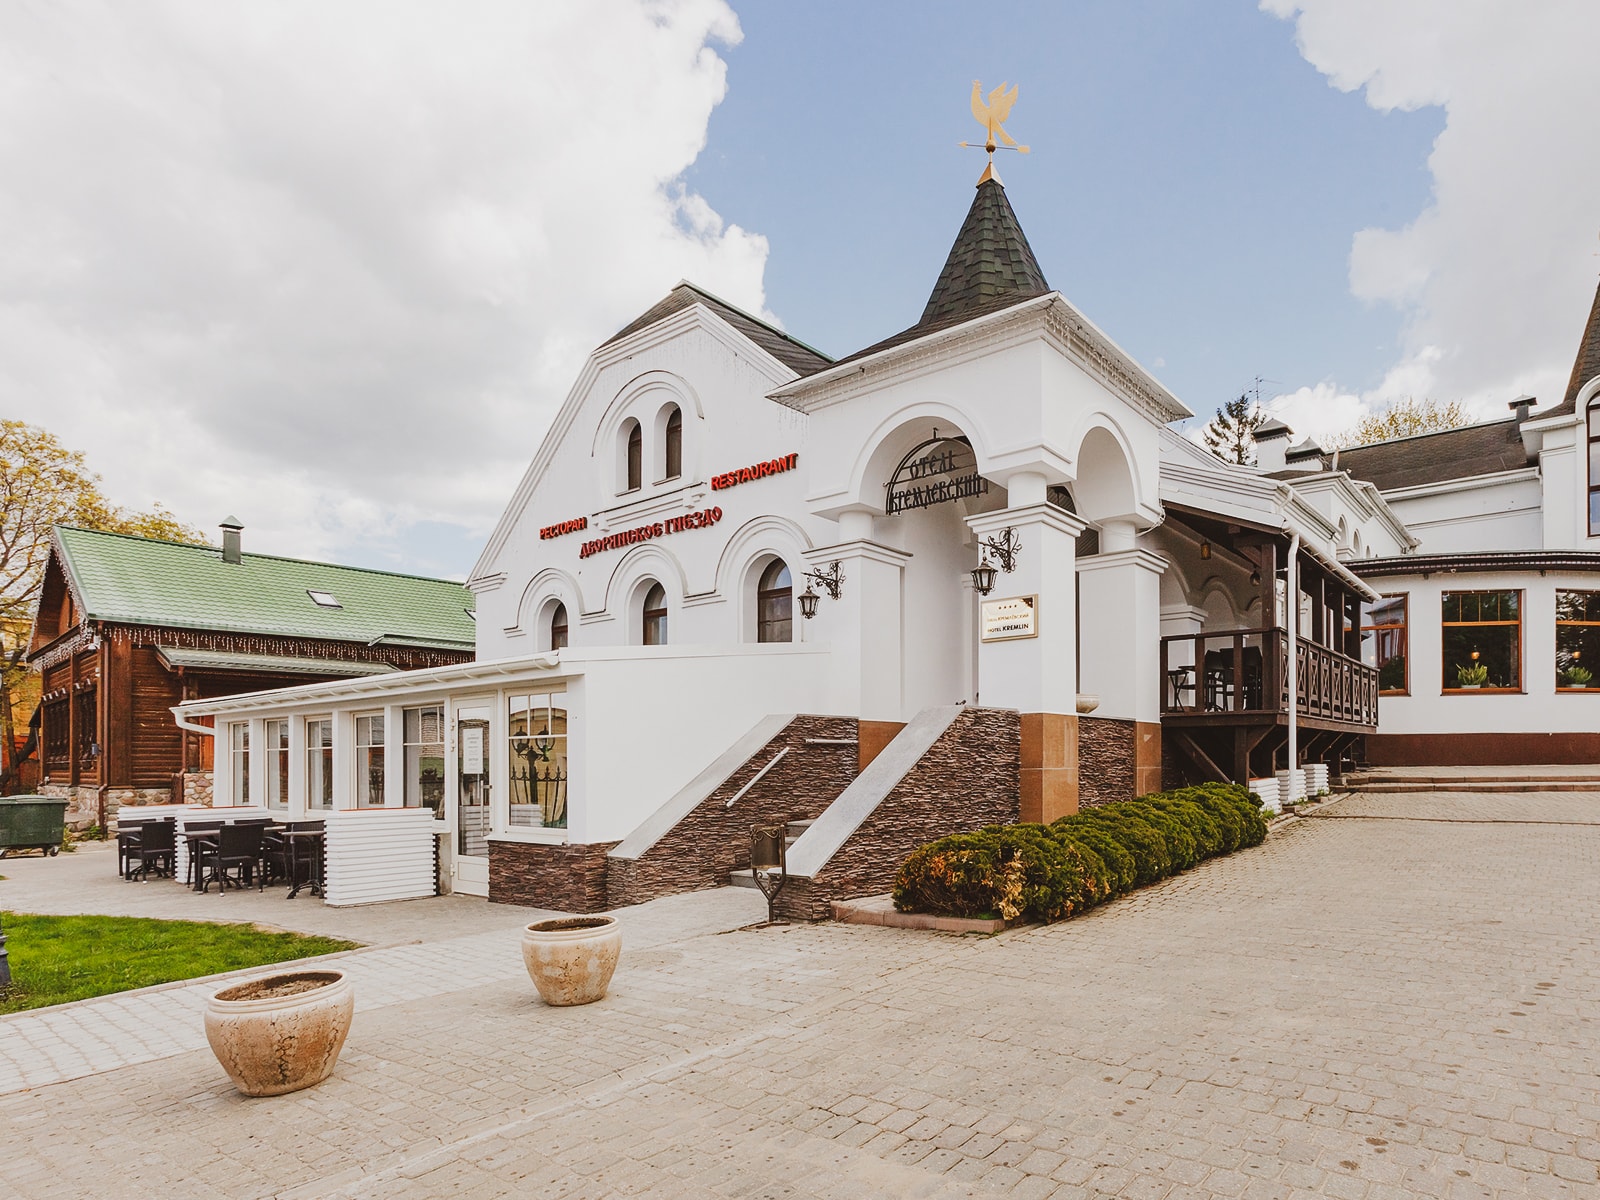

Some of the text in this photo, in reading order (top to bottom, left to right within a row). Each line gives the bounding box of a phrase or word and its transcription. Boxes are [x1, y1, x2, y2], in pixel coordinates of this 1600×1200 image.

[711, 452, 798, 491] RESTAURANT
[539, 516, 588, 540] РЕСТОРАН
[579, 506, 723, 559] ДВОРЯНСКОЕ ГНЕЗДО
[1002, 623, 1029, 632] KREMLIN
